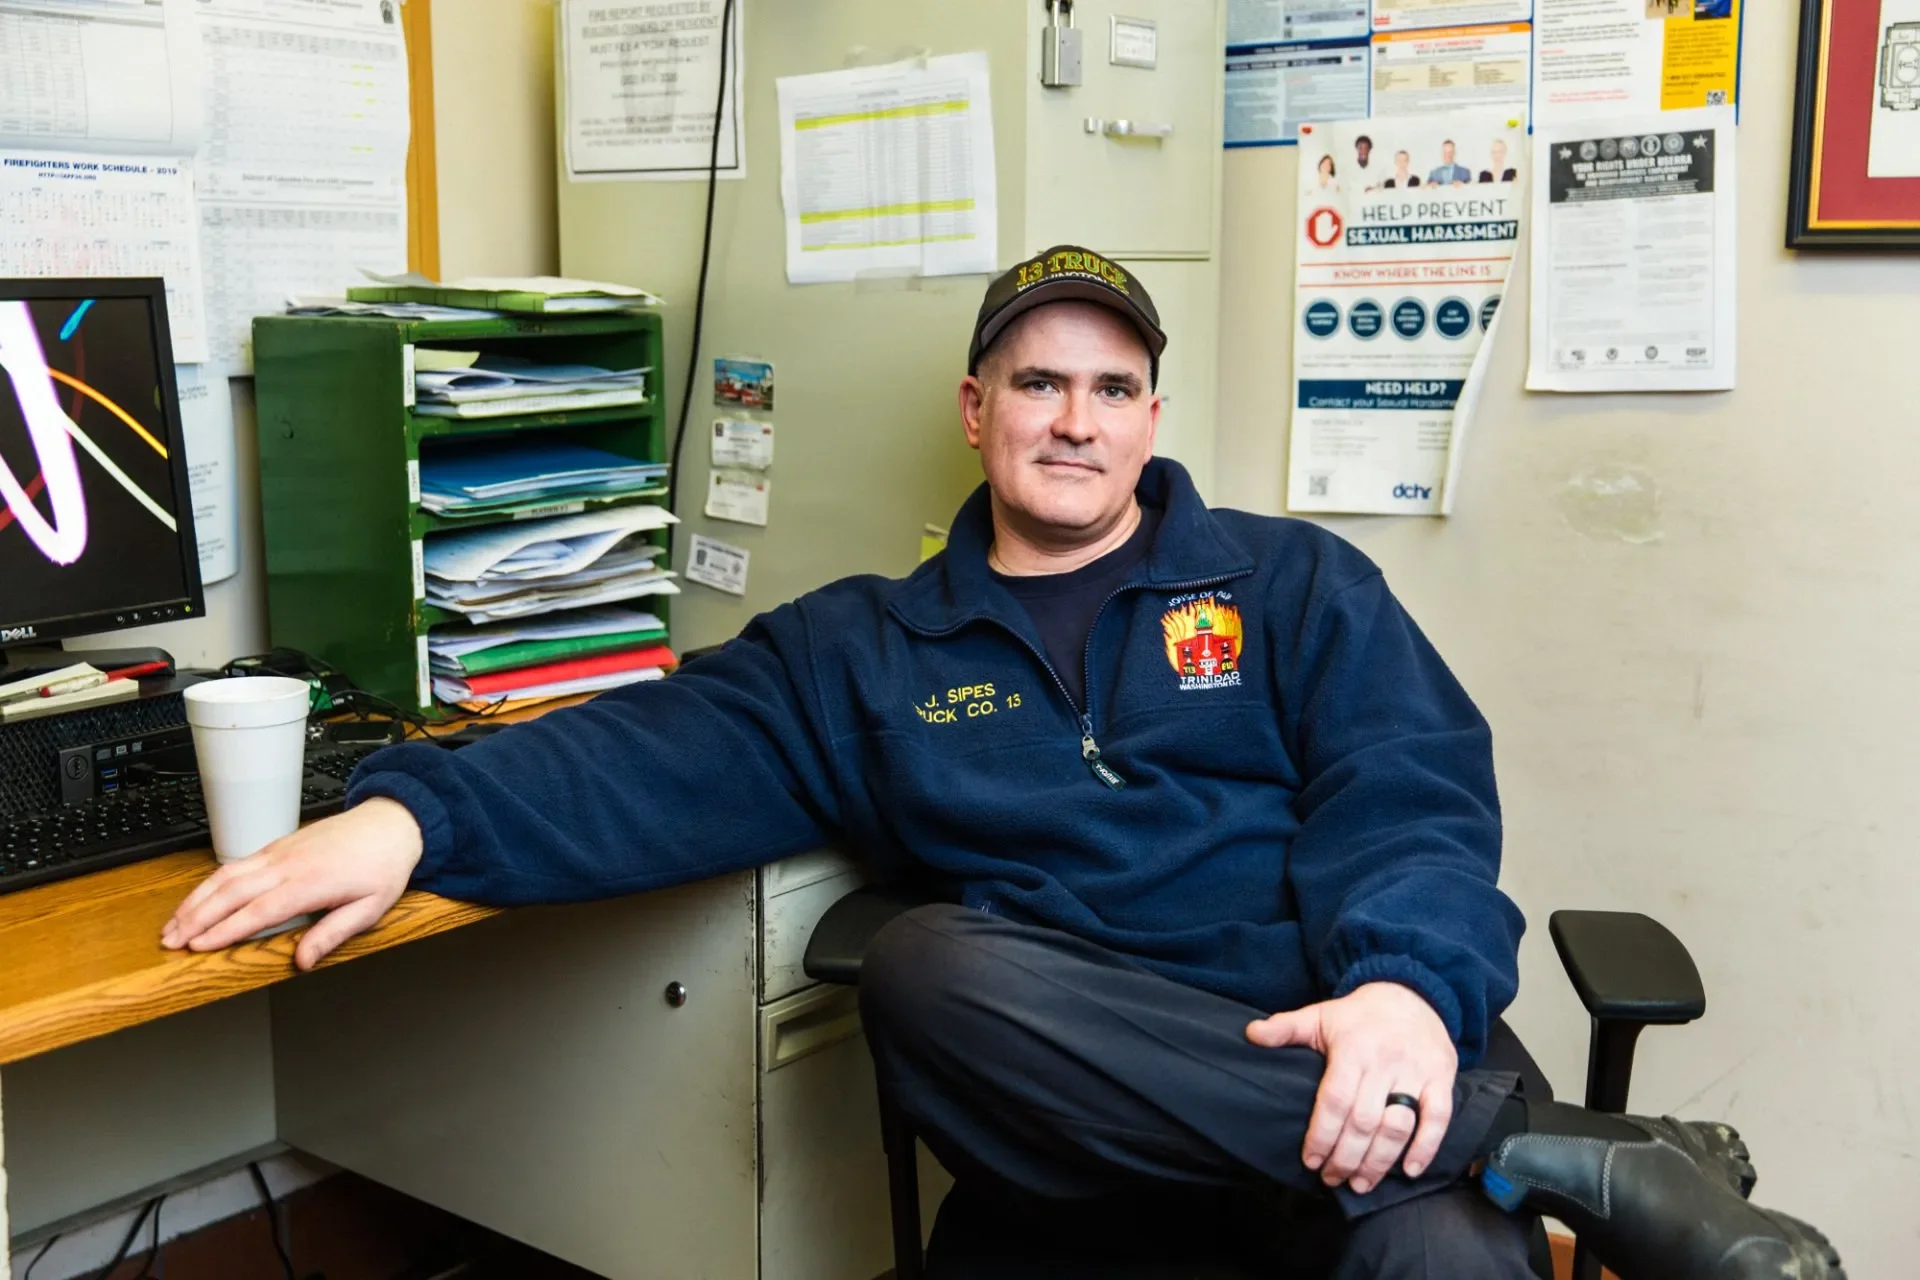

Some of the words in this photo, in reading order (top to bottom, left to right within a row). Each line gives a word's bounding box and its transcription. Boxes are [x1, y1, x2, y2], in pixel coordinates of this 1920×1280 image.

[4, 158, 70, 169] FIREFIGHTERS
[73, 162, 99, 171] WORK
[102, 163, 147, 174] SCHEDULE
[157, 167, 178, 175] 2019
[1362, 203, 1412, 221] HELP
[1418, 199, 1508, 219] PREVENT
[1348, 228, 1408, 245] SEXUAL
[1411, 222, 1516, 242] HARASSMENT
[1016, 262, 1043, 288] 13
[1047, 251, 1128, 289] TRUCK
[1333, 268, 1372, 280] KNOW
[1377, 266, 1417, 278] WHERE
[1423, 266, 1446, 277] THE
[1449, 265, 1477, 277] LINE
[1481, 264, 1492, 276] IS
[1365, 382, 1402, 395] NEED
[1404, 382, 1447, 395] HELP?
[1308, 396, 1350, 408] Contact
[1352, 398, 1375, 409] your
[1377, 396, 1408, 408] Sexual
[0, 626, 37, 642] DELL
[1180, 671, 1240, 685] TRINIDAD
[925, 694, 940, 708] J.
[947, 682, 996, 704] SIPES
[912, 702, 958, 723] UCK
[967, 700, 998, 718] CO.
[1006, 693, 1022, 709] 13
